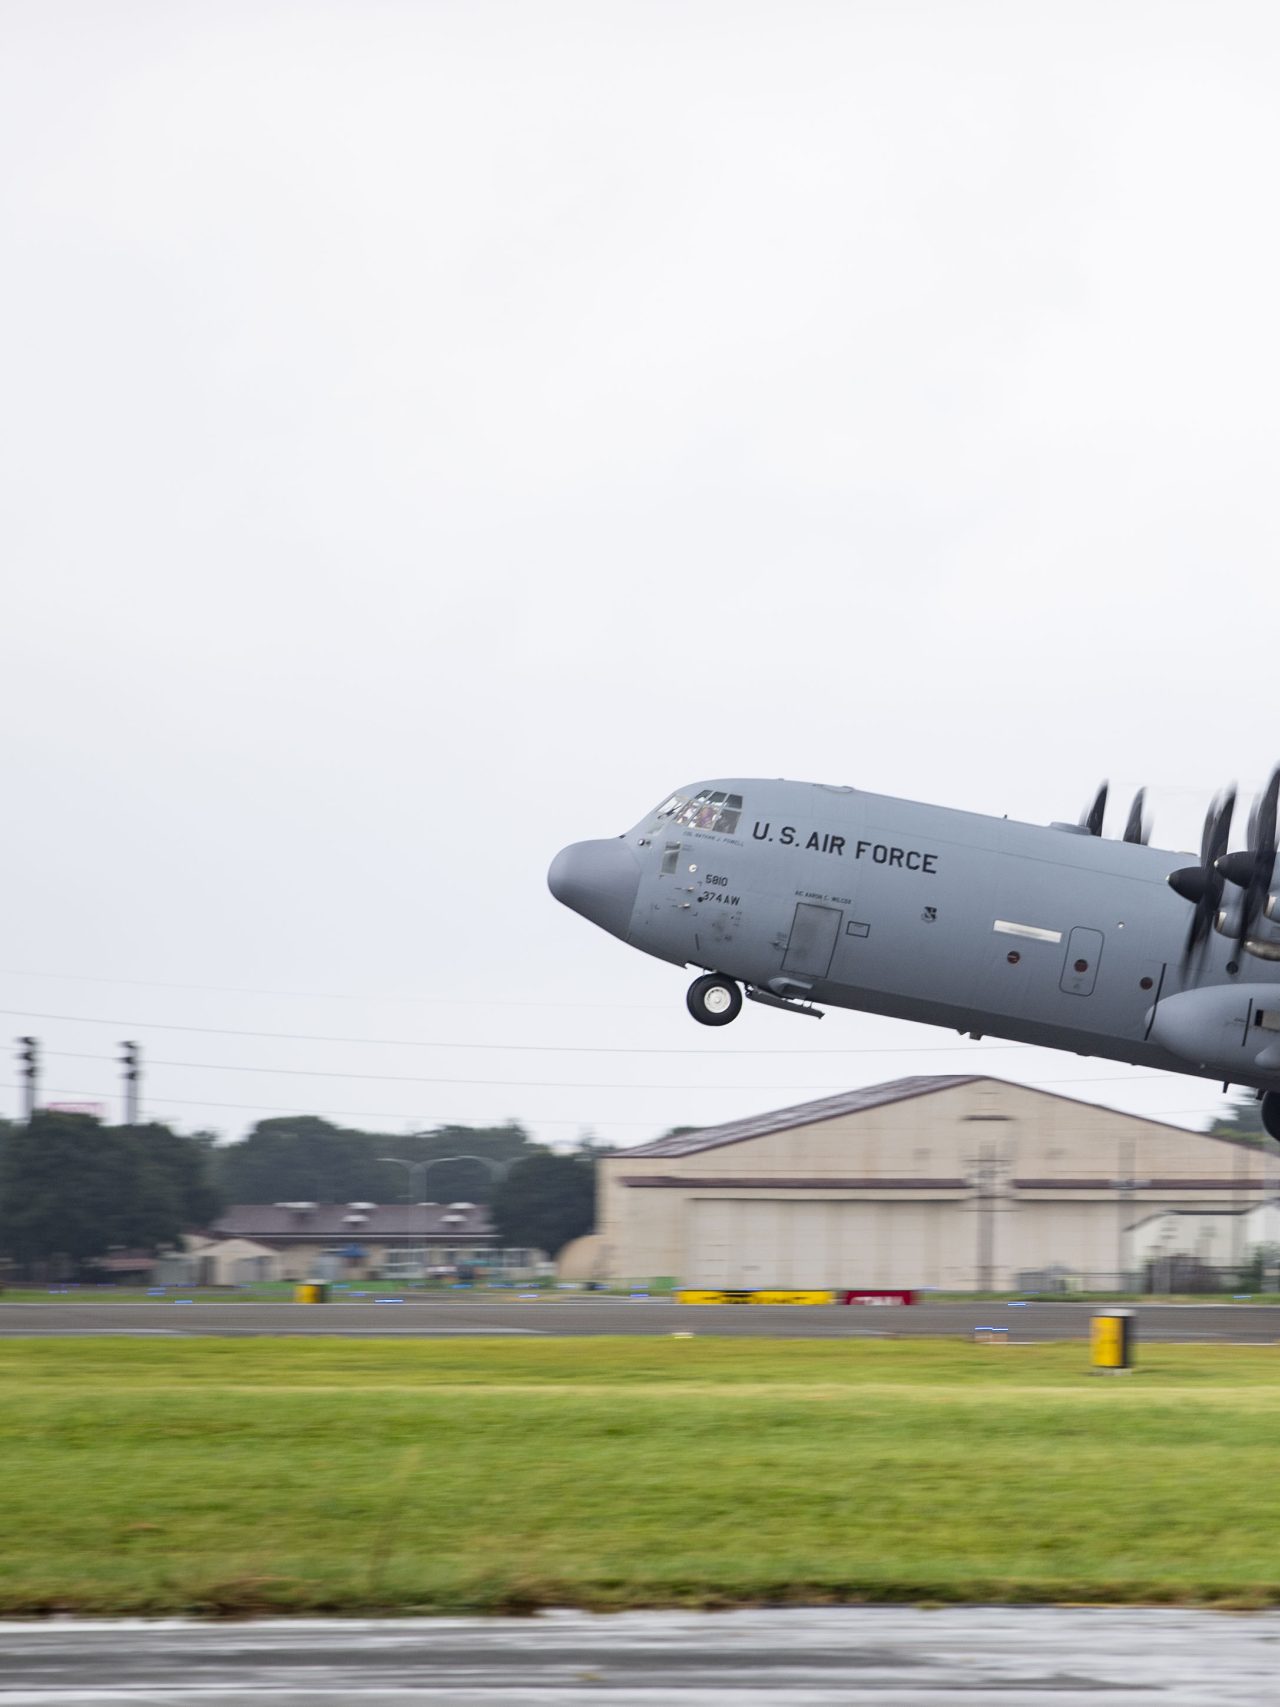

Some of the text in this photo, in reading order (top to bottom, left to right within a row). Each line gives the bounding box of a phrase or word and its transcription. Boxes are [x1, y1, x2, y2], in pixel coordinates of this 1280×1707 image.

[752, 821, 939, 874] U.S. AIR FORCE
[705, 874, 728, 887] 5810
